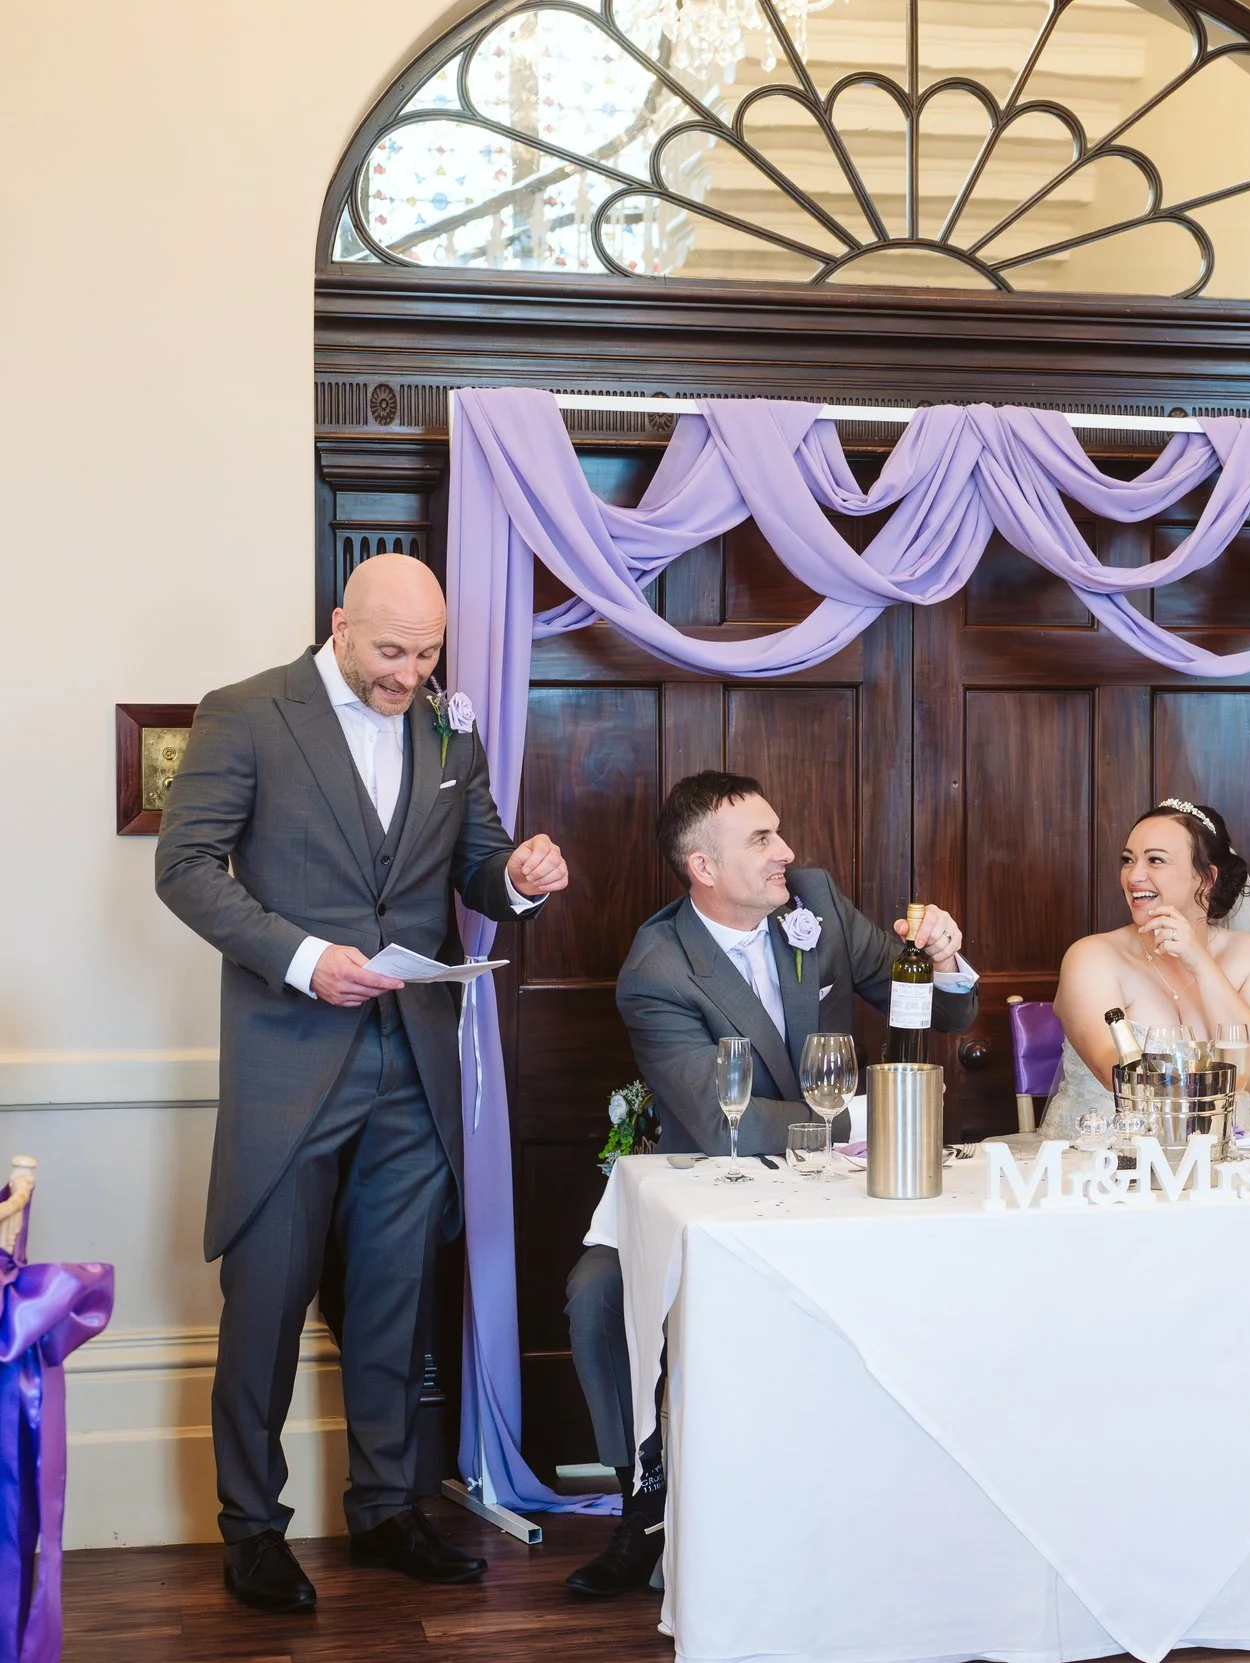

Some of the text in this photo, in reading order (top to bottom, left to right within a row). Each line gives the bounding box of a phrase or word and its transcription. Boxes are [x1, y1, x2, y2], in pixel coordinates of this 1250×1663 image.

[983, 1140, 1090, 1209] Mr
[1087, 1148, 1142, 1204] &
[640, 1473, 664, 1487] GROO
